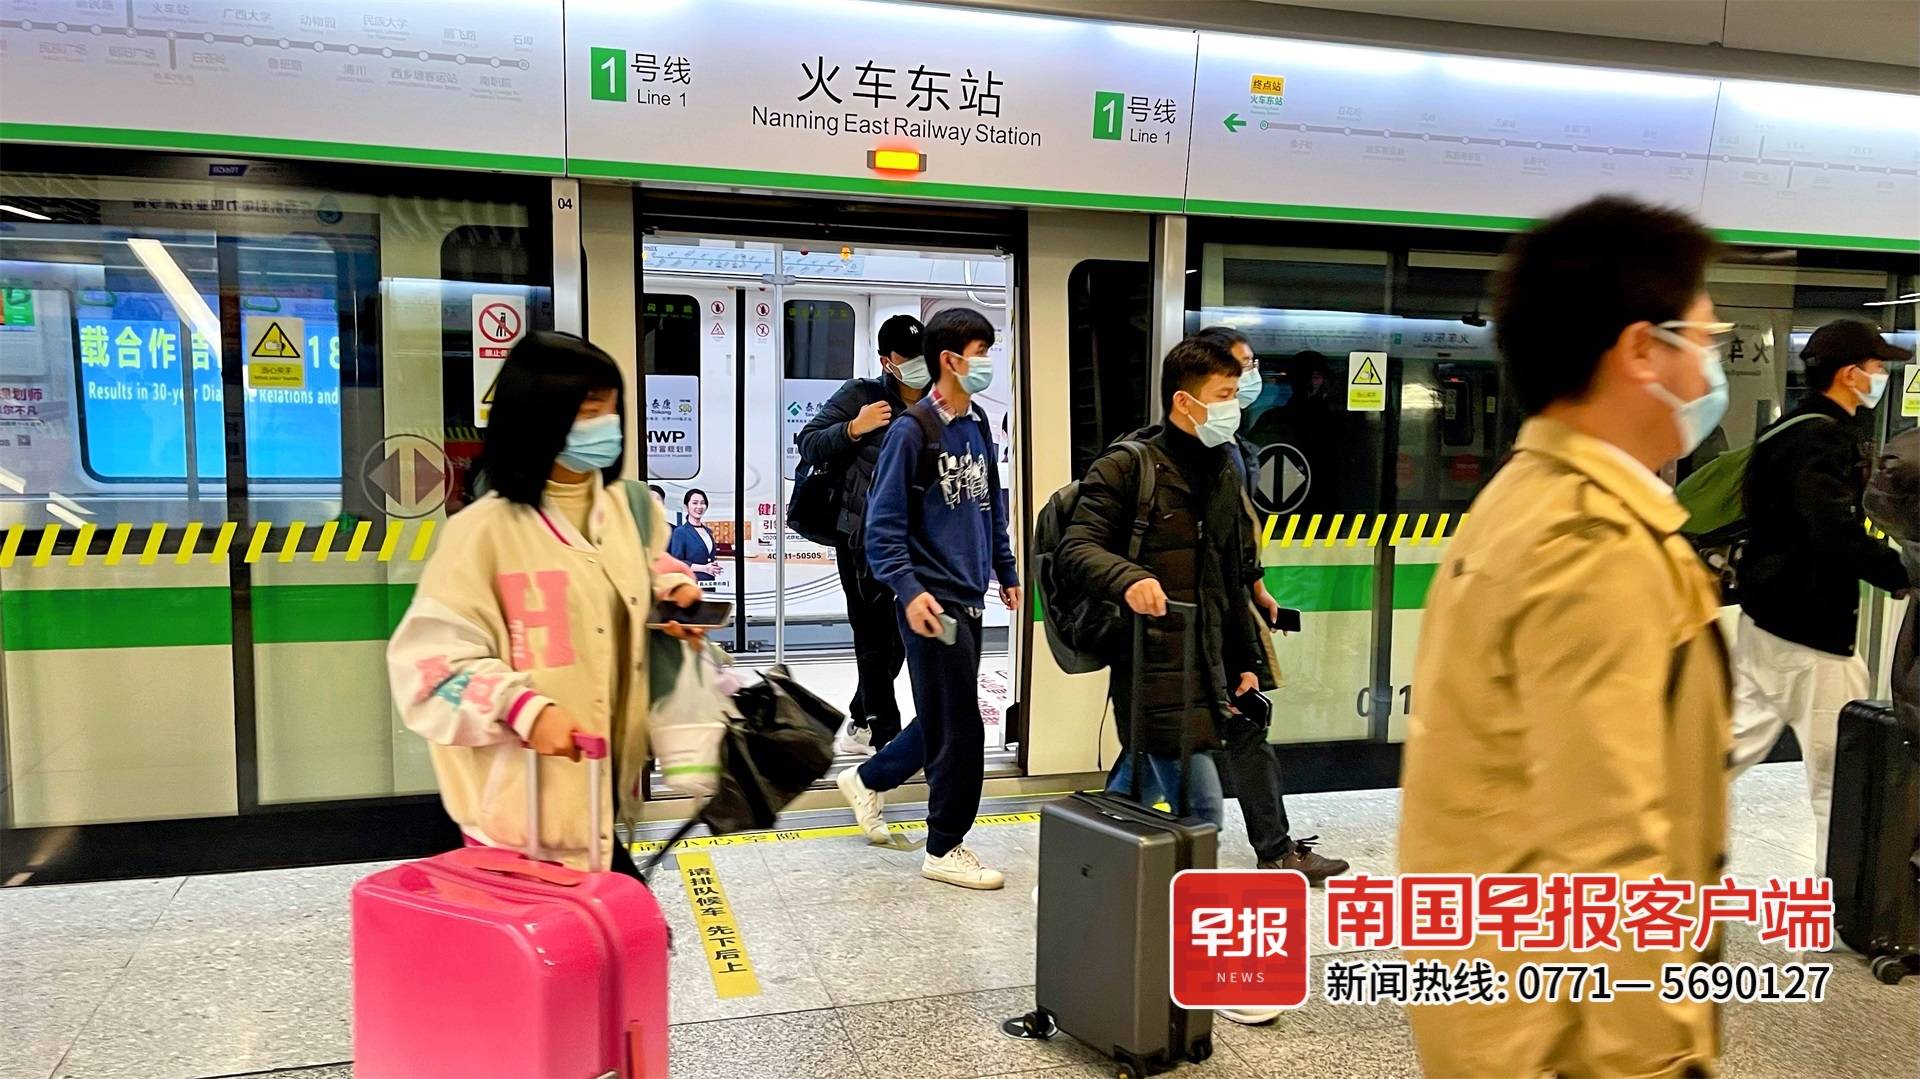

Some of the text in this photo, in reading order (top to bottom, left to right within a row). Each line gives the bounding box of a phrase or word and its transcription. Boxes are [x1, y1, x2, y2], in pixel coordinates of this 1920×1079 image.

[631, 53, 691, 85] 号线
[637, 88, 686, 107] Line 1
[797, 55, 1004, 118] 火车东站
[1252, 79, 1281, 91] 终点站
[1127, 96, 1176, 124] 号线
[752, 105, 1041, 147] Nanning East Railway Station
[1130, 128, 1170, 145] Line 1
[558, 197, 573, 210] 04
[88, 381, 132, 400] Results
[137, 382, 148, 399] in
[152, 383, 198, 405] 30-yer
[317, 386, 338, 405] and
[687, 867, 748, 974] 请排队候车 先下后上
